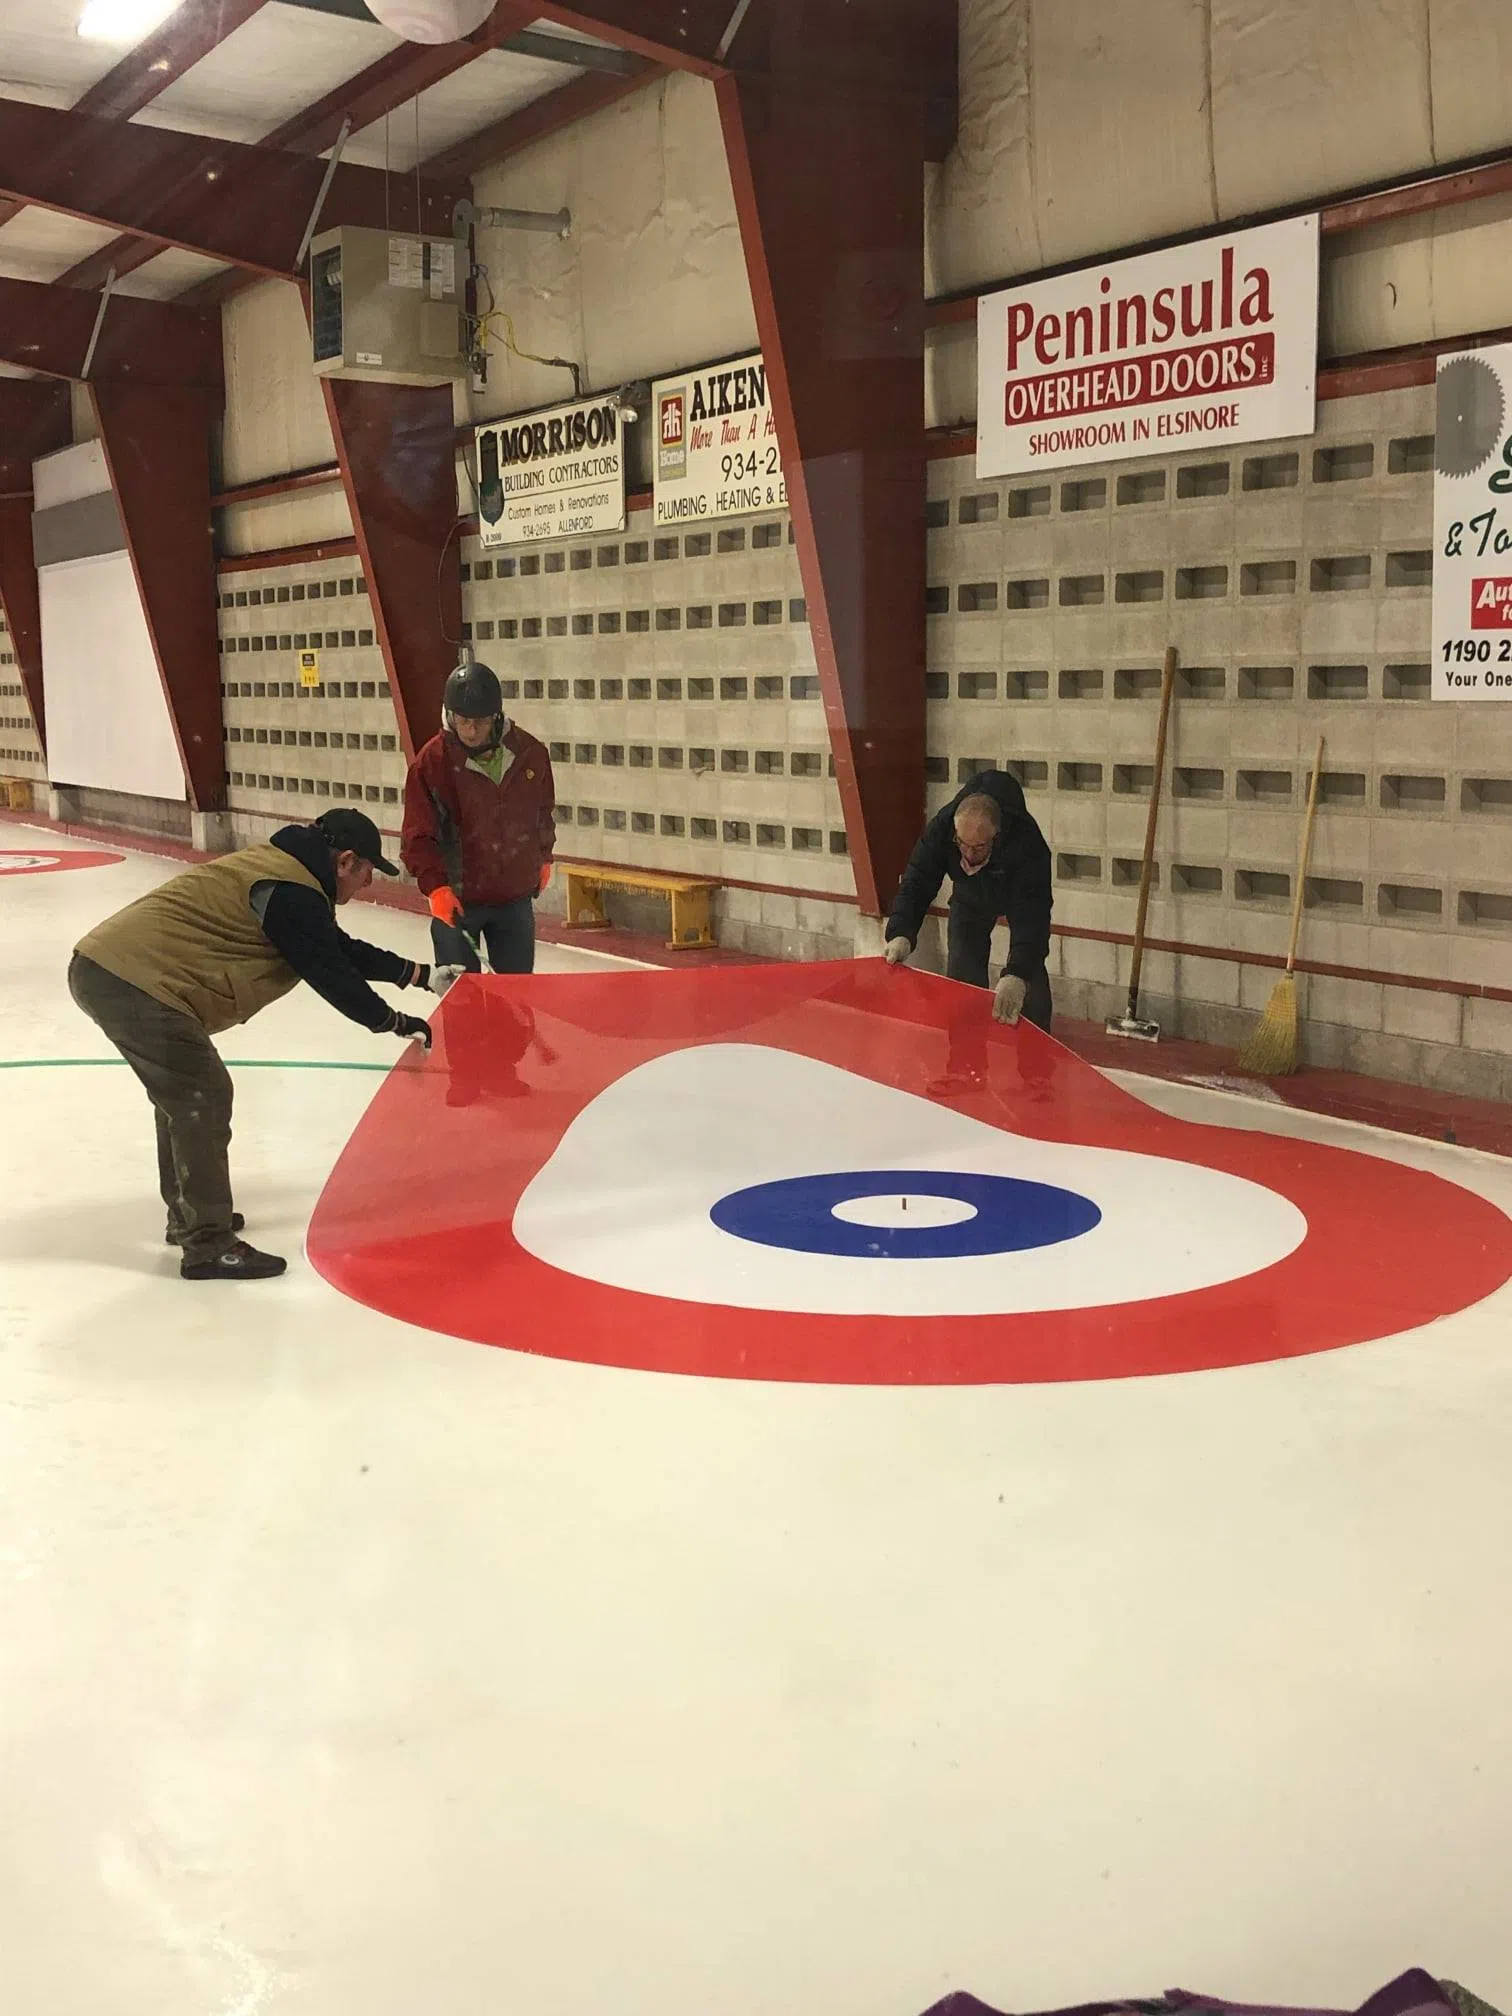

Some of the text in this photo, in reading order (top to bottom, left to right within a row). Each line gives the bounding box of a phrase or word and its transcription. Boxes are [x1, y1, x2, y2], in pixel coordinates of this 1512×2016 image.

[1007, 247, 1274, 372] Peninsula
[690, 364, 766, 422] AIKEN
[1008, 341, 1256, 420] OVERHEAD DOORS
[500, 405, 616, 467] MORRISON
[690, 425, 714, 452] More
[720, 419, 741, 446] Than
[747, 413, 758, 441] A
[1029, 404, 1240, 456] SHOWROOM IN ELSINORE
[505, 455, 619, 493] BUILDING CONTRACTORS
[721, 446, 783, 482] 934-2
[508, 507, 531, 520] Custom
[534, 502, 556, 515] Homes
[568, 493, 609, 510] Renovations
[716, 486, 762, 512] HEATING
[766, 487, 775, 504] &
[558, 516, 594, 534] ALLENFORD
[1442, 639, 1512, 662] 1190 2
[1445, 670, 1512, 687] Your One
